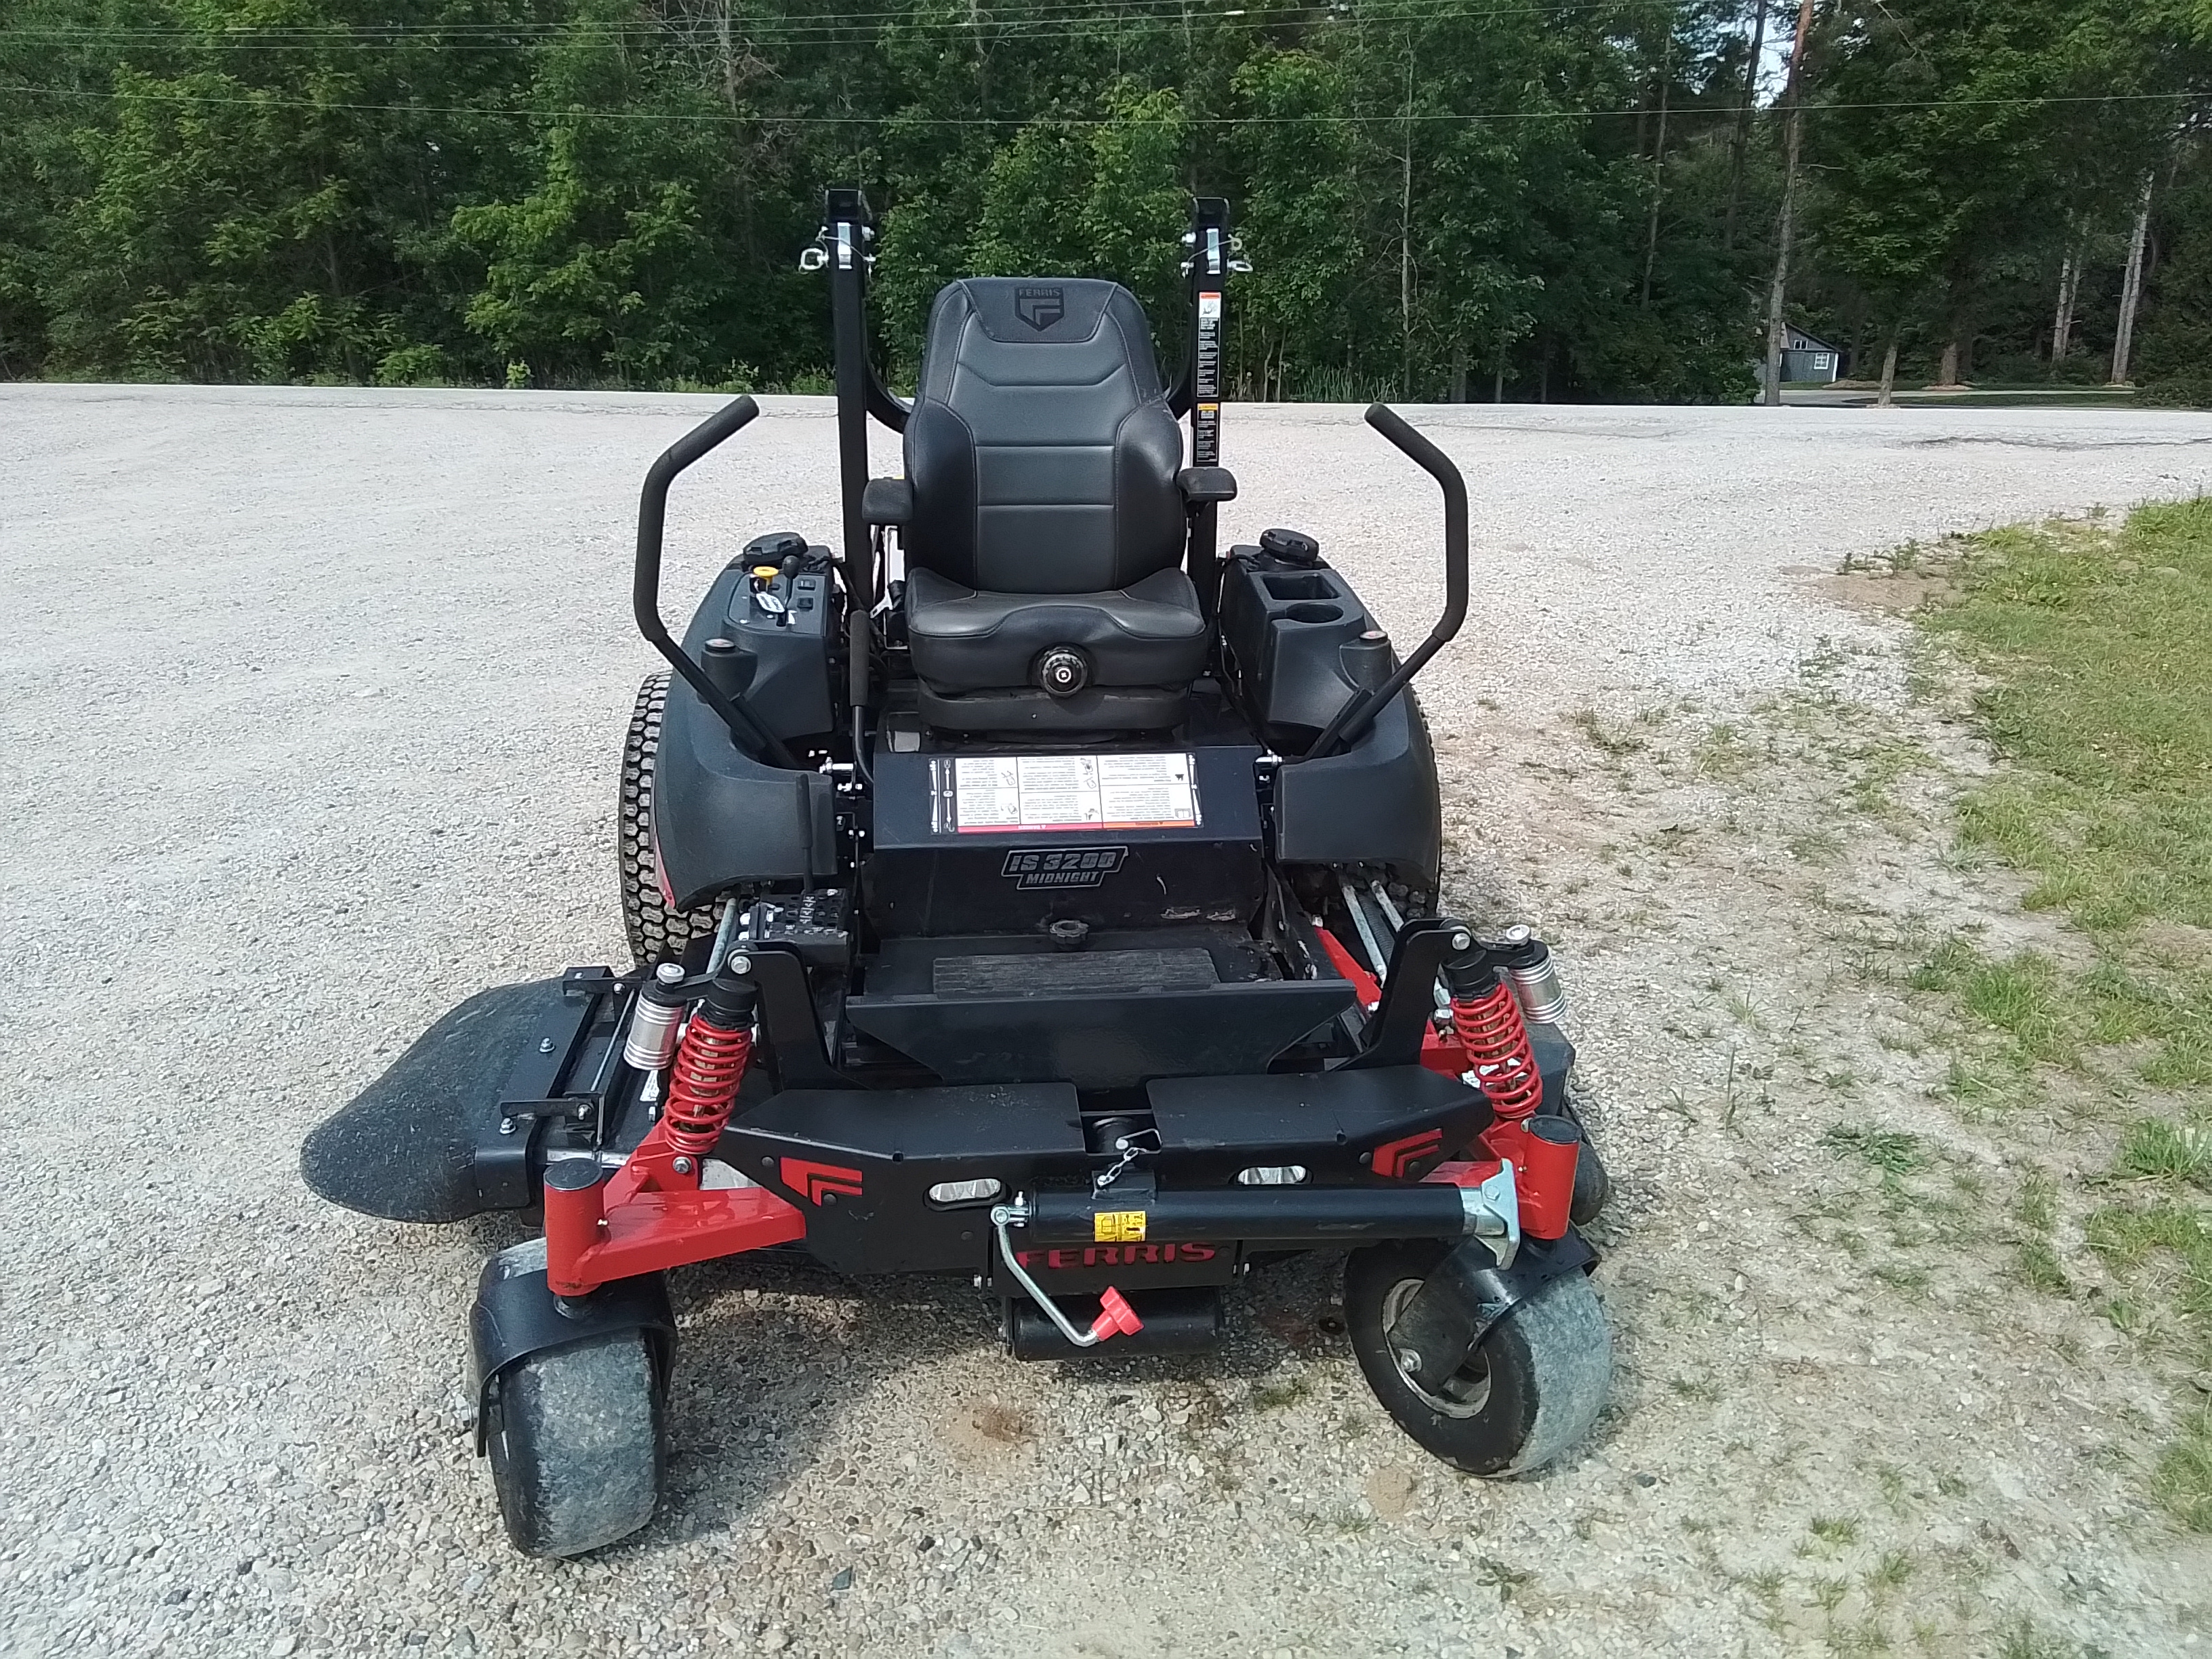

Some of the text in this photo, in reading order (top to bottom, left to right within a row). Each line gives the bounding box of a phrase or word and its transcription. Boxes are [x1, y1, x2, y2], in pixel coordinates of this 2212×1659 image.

[1018, 287, 1061, 298] FERRIS
[1008, 852, 1117, 872] IS 3200
[1025, 872, 1099, 884] MIDNIGHT
[1015, 1242, 1216, 1269] FERRIS
